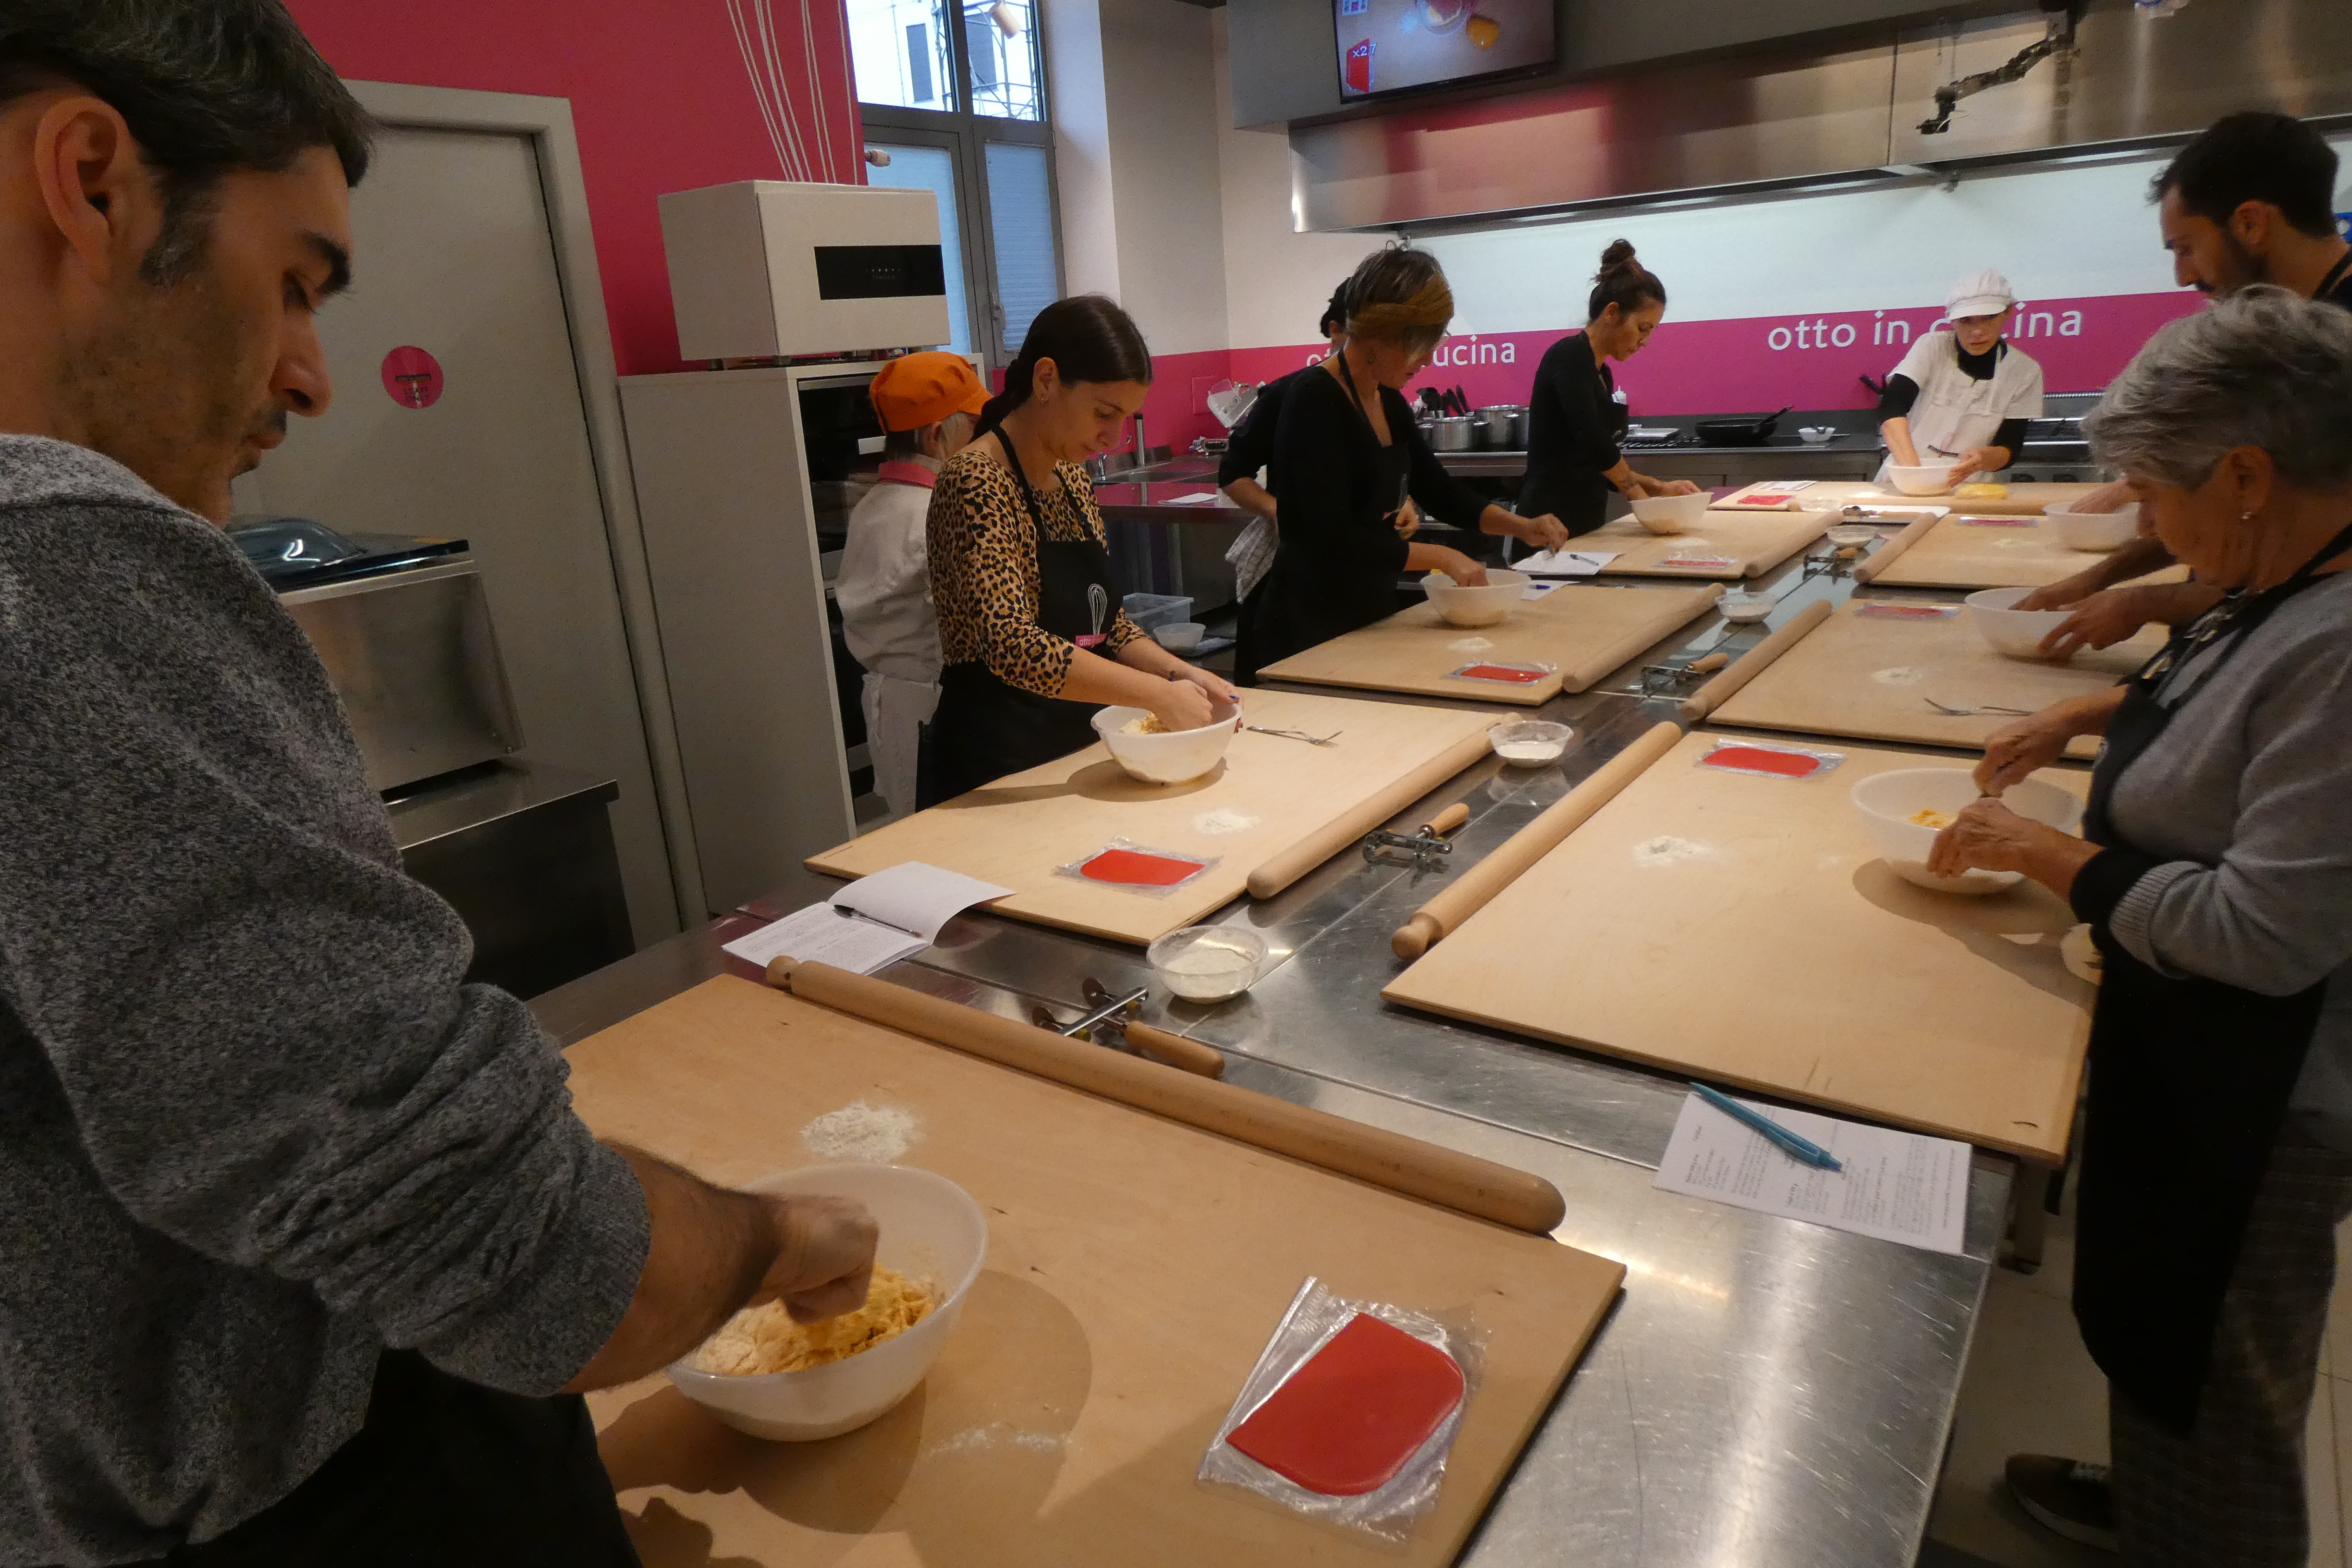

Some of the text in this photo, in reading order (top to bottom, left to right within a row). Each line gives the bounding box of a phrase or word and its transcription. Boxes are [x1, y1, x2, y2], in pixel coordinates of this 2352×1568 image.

[1768, 318, 1856, 351] otto
[1874, 310, 1910, 345] in
[1423, 334, 1515, 367] ucina
